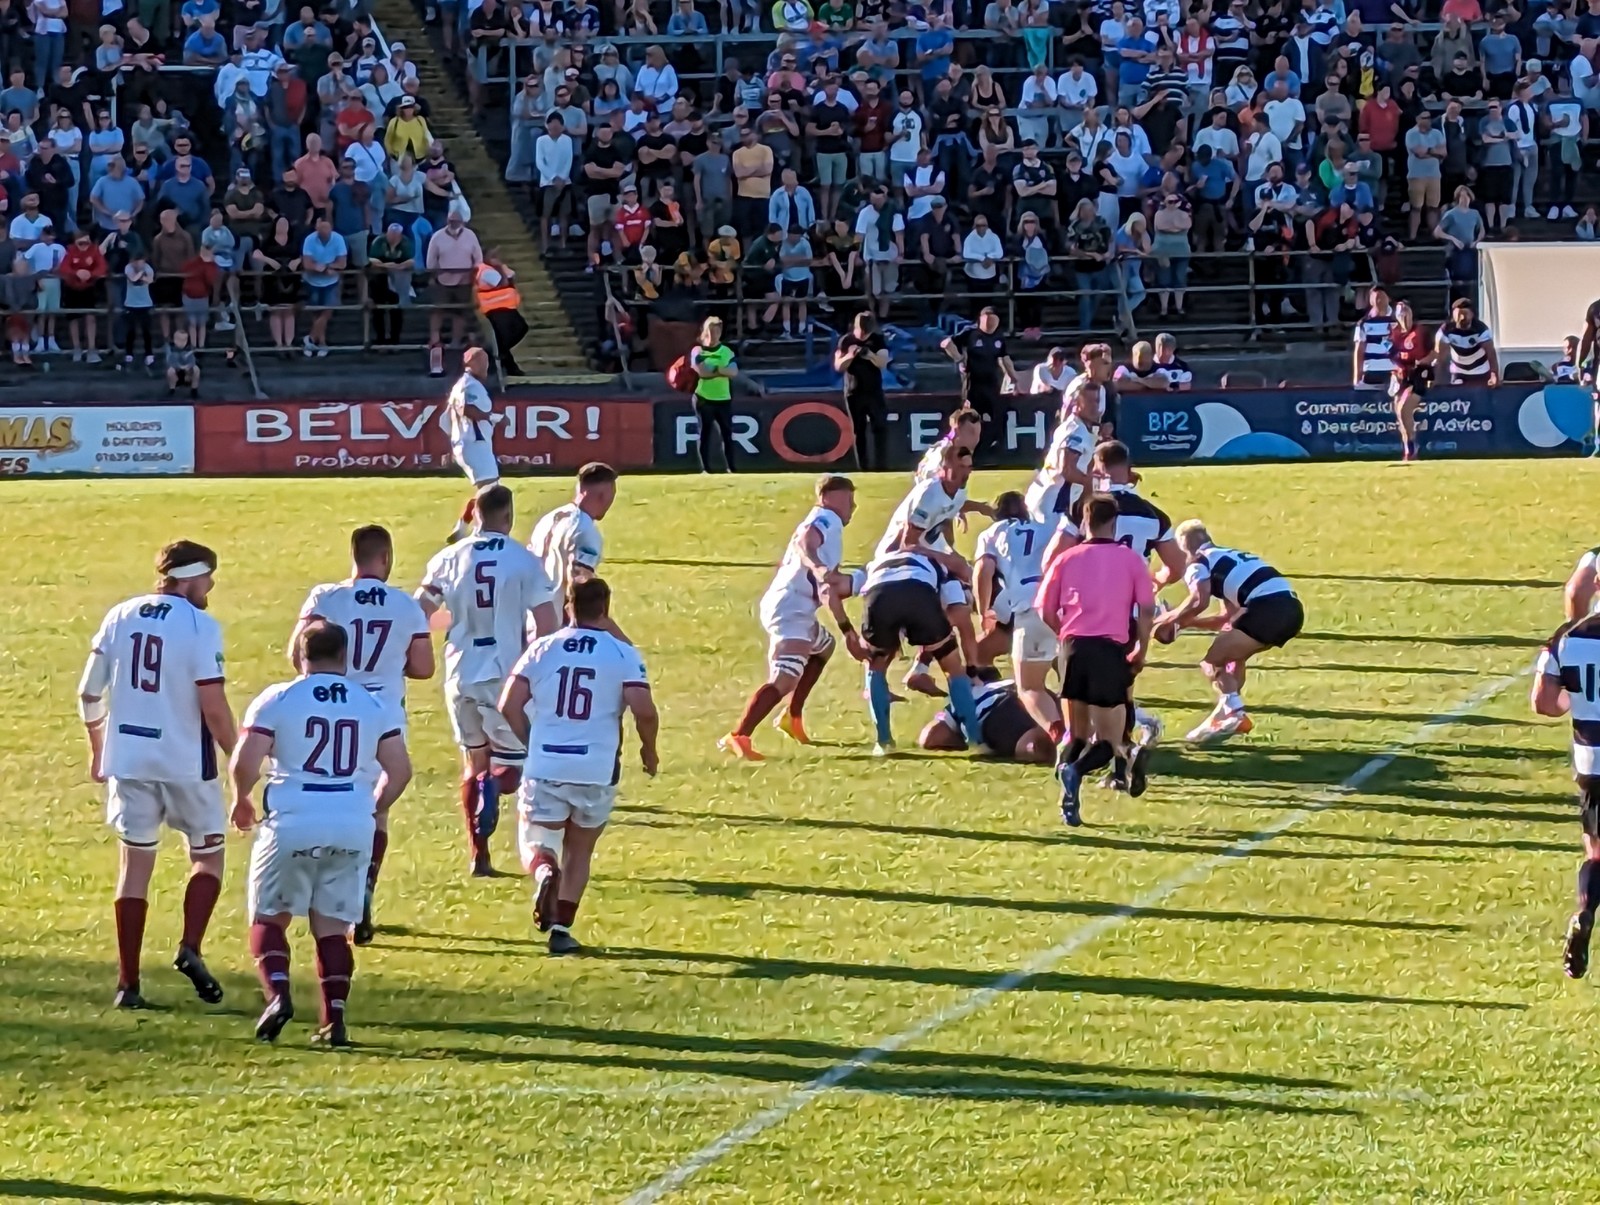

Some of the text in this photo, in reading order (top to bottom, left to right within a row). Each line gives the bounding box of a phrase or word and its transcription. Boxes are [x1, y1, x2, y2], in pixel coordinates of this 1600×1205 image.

[246, 402, 600, 443] BELVIR!
[1148, 411, 1189, 431] BP2
[1301, 420, 1312, 434] &
[1014, 528, 1035, 556] 7
[475, 560, 497, 608] 5
[129, 631, 164, 693] 19
[350, 618, 393, 672] 17
[555, 665, 596, 721] 16
[302, 715, 359, 777] 20
